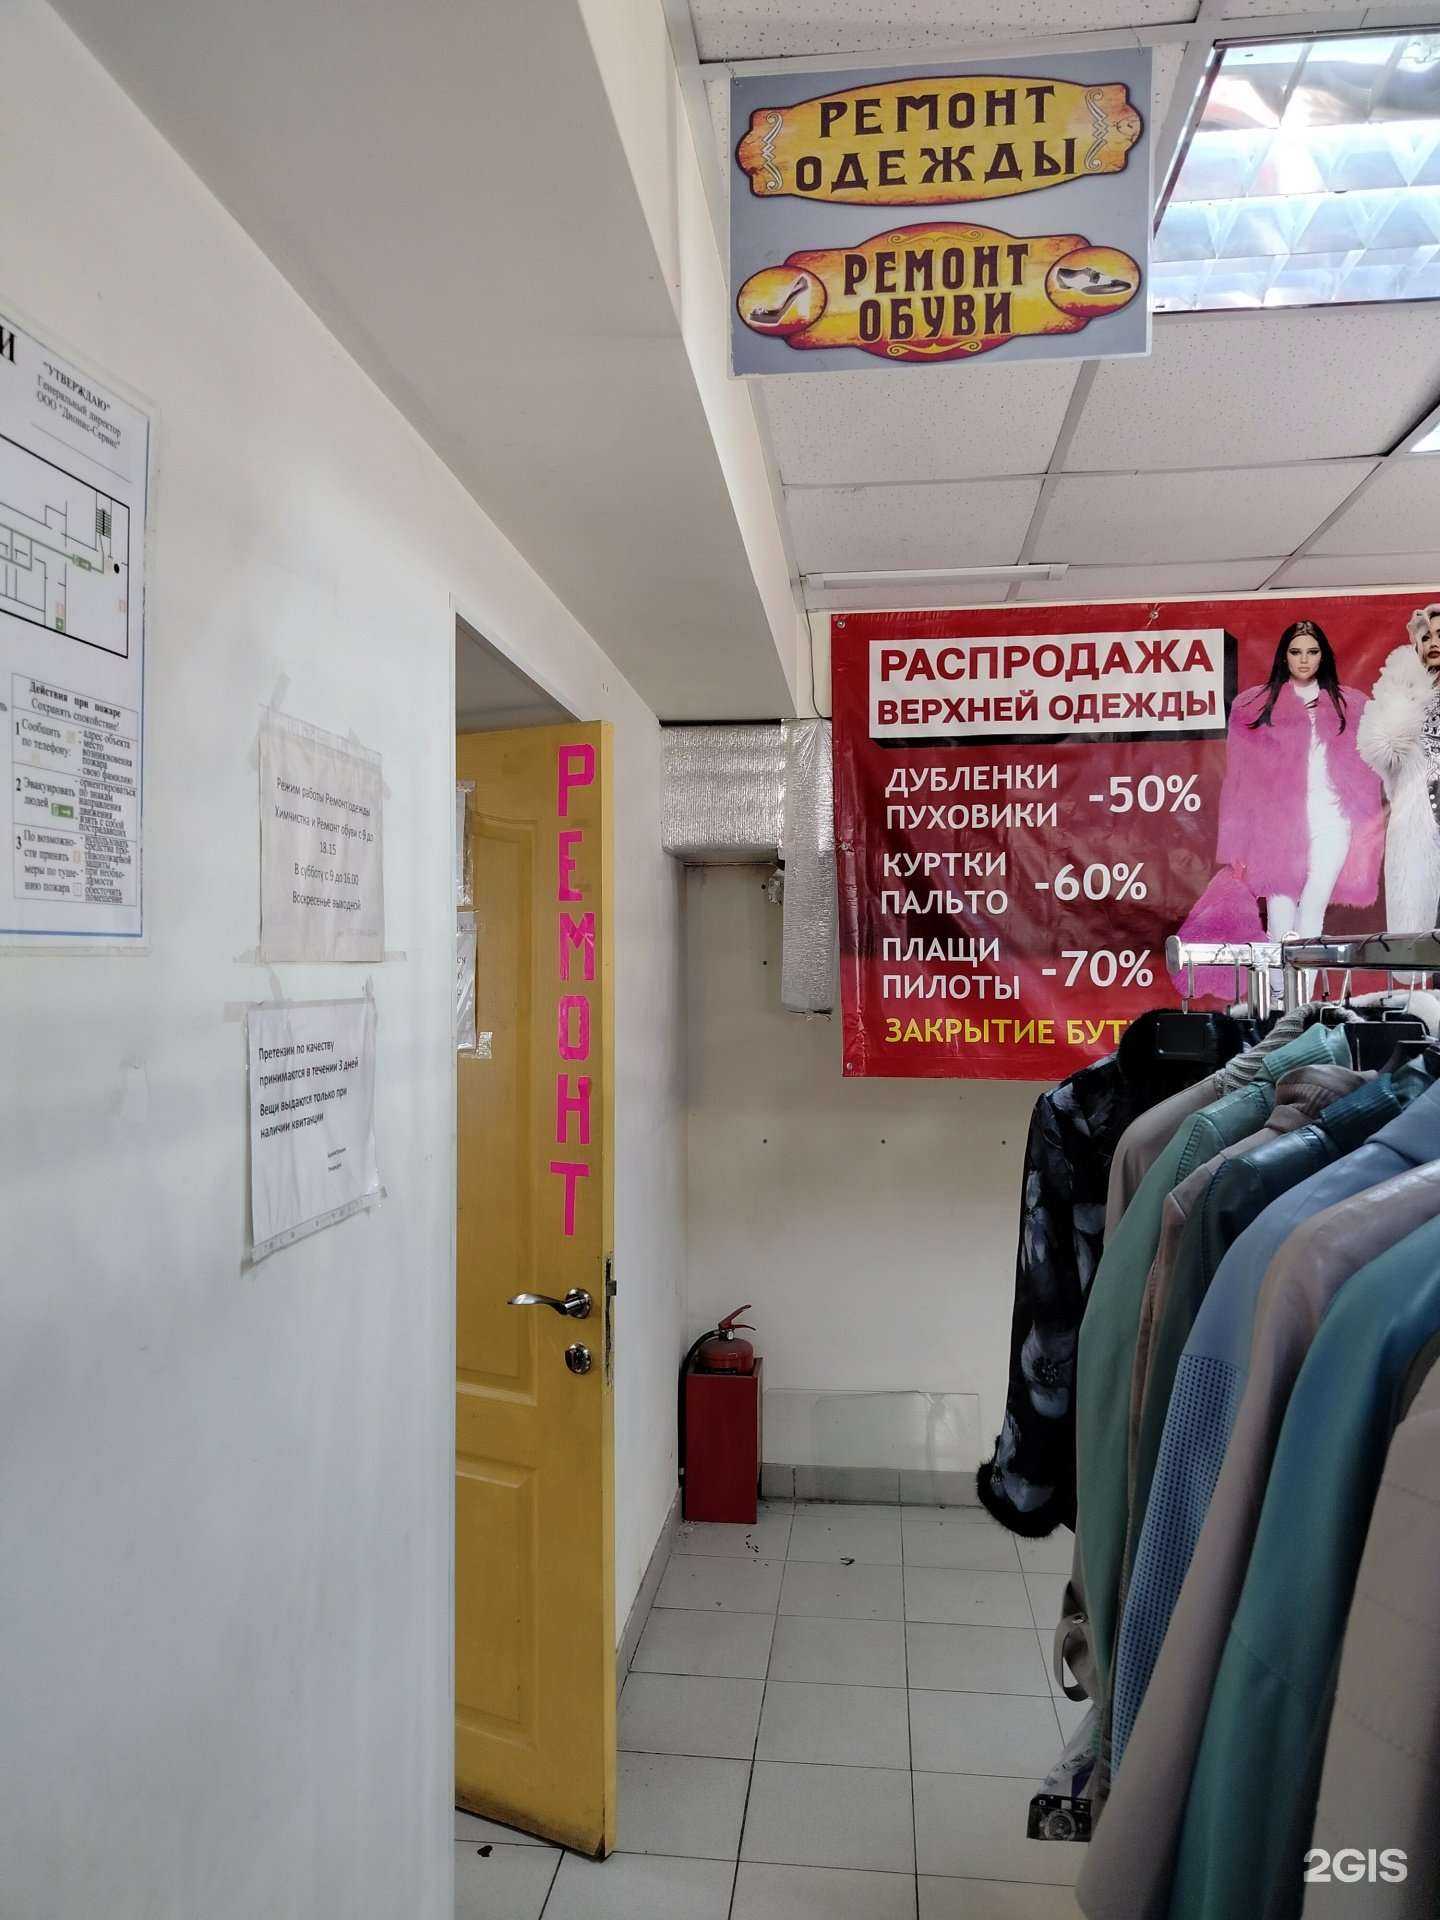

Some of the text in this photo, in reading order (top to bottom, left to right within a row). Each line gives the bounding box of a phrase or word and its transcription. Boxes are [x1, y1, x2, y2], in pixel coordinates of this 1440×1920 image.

[819, 84, 1055, 139] РЕМОНТ
[795, 137, 1080, 194] ОДЕЖДЫ
[843, 242, 1032, 296] РЕМОНТ
[858, 291, 1013, 343] ОБУВИ
[880, 639, 1214, 682] РАСПРОДАЖА
[30, 681, 121, 719] Действия при пожаре
[877, 688, 1217, 726] ВЕРХНЕЙ ОДЕЖДЫ
[277, 776, 300, 794] Режим
[325, 793, 348, 809] Ремонт
[885, 764, 1058, 799] ДУБЛЕНКИ
[1088, 774, 1201, 814] -50%
[274, 804, 310, 825] Химчистка
[317, 816, 340, 832] Ремонт
[885, 802, 1058, 830] ПУХОВИКИ
[883, 851, 1006, 878] КУРТКИ
[1034, 862, 1147, 901] -60%
[881, 889, 1008, 915] ПАЛЬТО
[882, 936, 1000, 968] ПЛАЩИ
[1041, 948, 1154, 988] -70%
[550, 742, 597, 1237] РЕМОНТ
[882, 973, 1020, 1000] ПИЛОТЫ
[884, 1016, 1133, 1045] ЗАКРЫТИЕ БУТ
[258, 1040, 335, 1062] Претензии по качеству
[259, 1069, 305, 1088] принимаются
[312, 1062, 337, 1077] течении
[338, 1060, 343, 1071] 3
[343, 1056, 359, 1071] дней
[260, 1088, 347, 1117] Вещи выдаются только при
[260, 1112, 324, 1139] наличии квитанции
